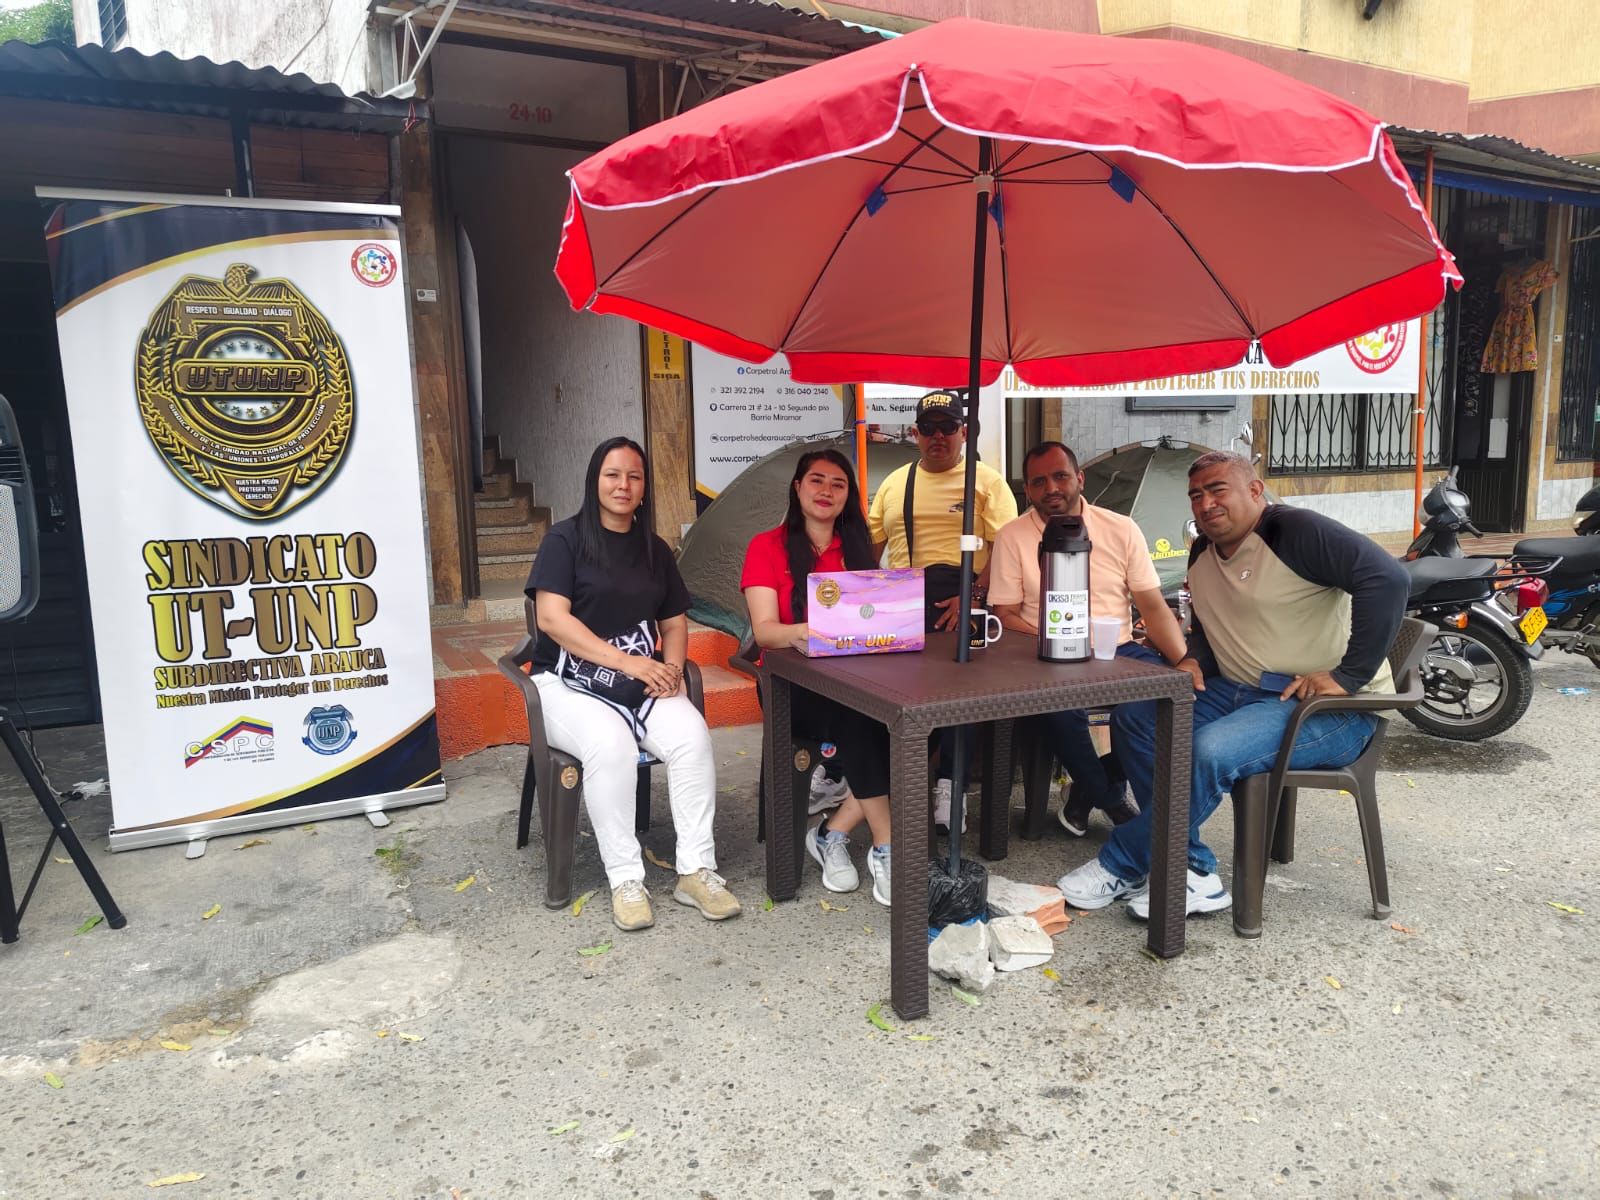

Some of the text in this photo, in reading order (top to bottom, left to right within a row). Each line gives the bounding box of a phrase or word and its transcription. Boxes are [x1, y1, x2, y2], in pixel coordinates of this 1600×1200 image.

[185, 306, 293, 316] RESPETO IGUALDAD DIÁLOGO
[746, 366, 778, 376] Corpetrol
[1220, 370, 1246, 390] TUS
[1250, 370, 1320, 389] DERECHOS
[720, 386, 732, 394] 321
[734, 386, 747, 394] 392
[788, 404, 816, 412] Segundo
[142, 531, 377, 591] SINDICATO
[148, 582, 378, 663] UT-UNP
[836, 635, 856, 650] UT
[865, 633, 897, 648] UNP
[154, 648, 388, 690] SUBDIRECTIVA ARAUCA
[156, 674, 389, 709] Nuestra Misión Proteger tus Derechos
